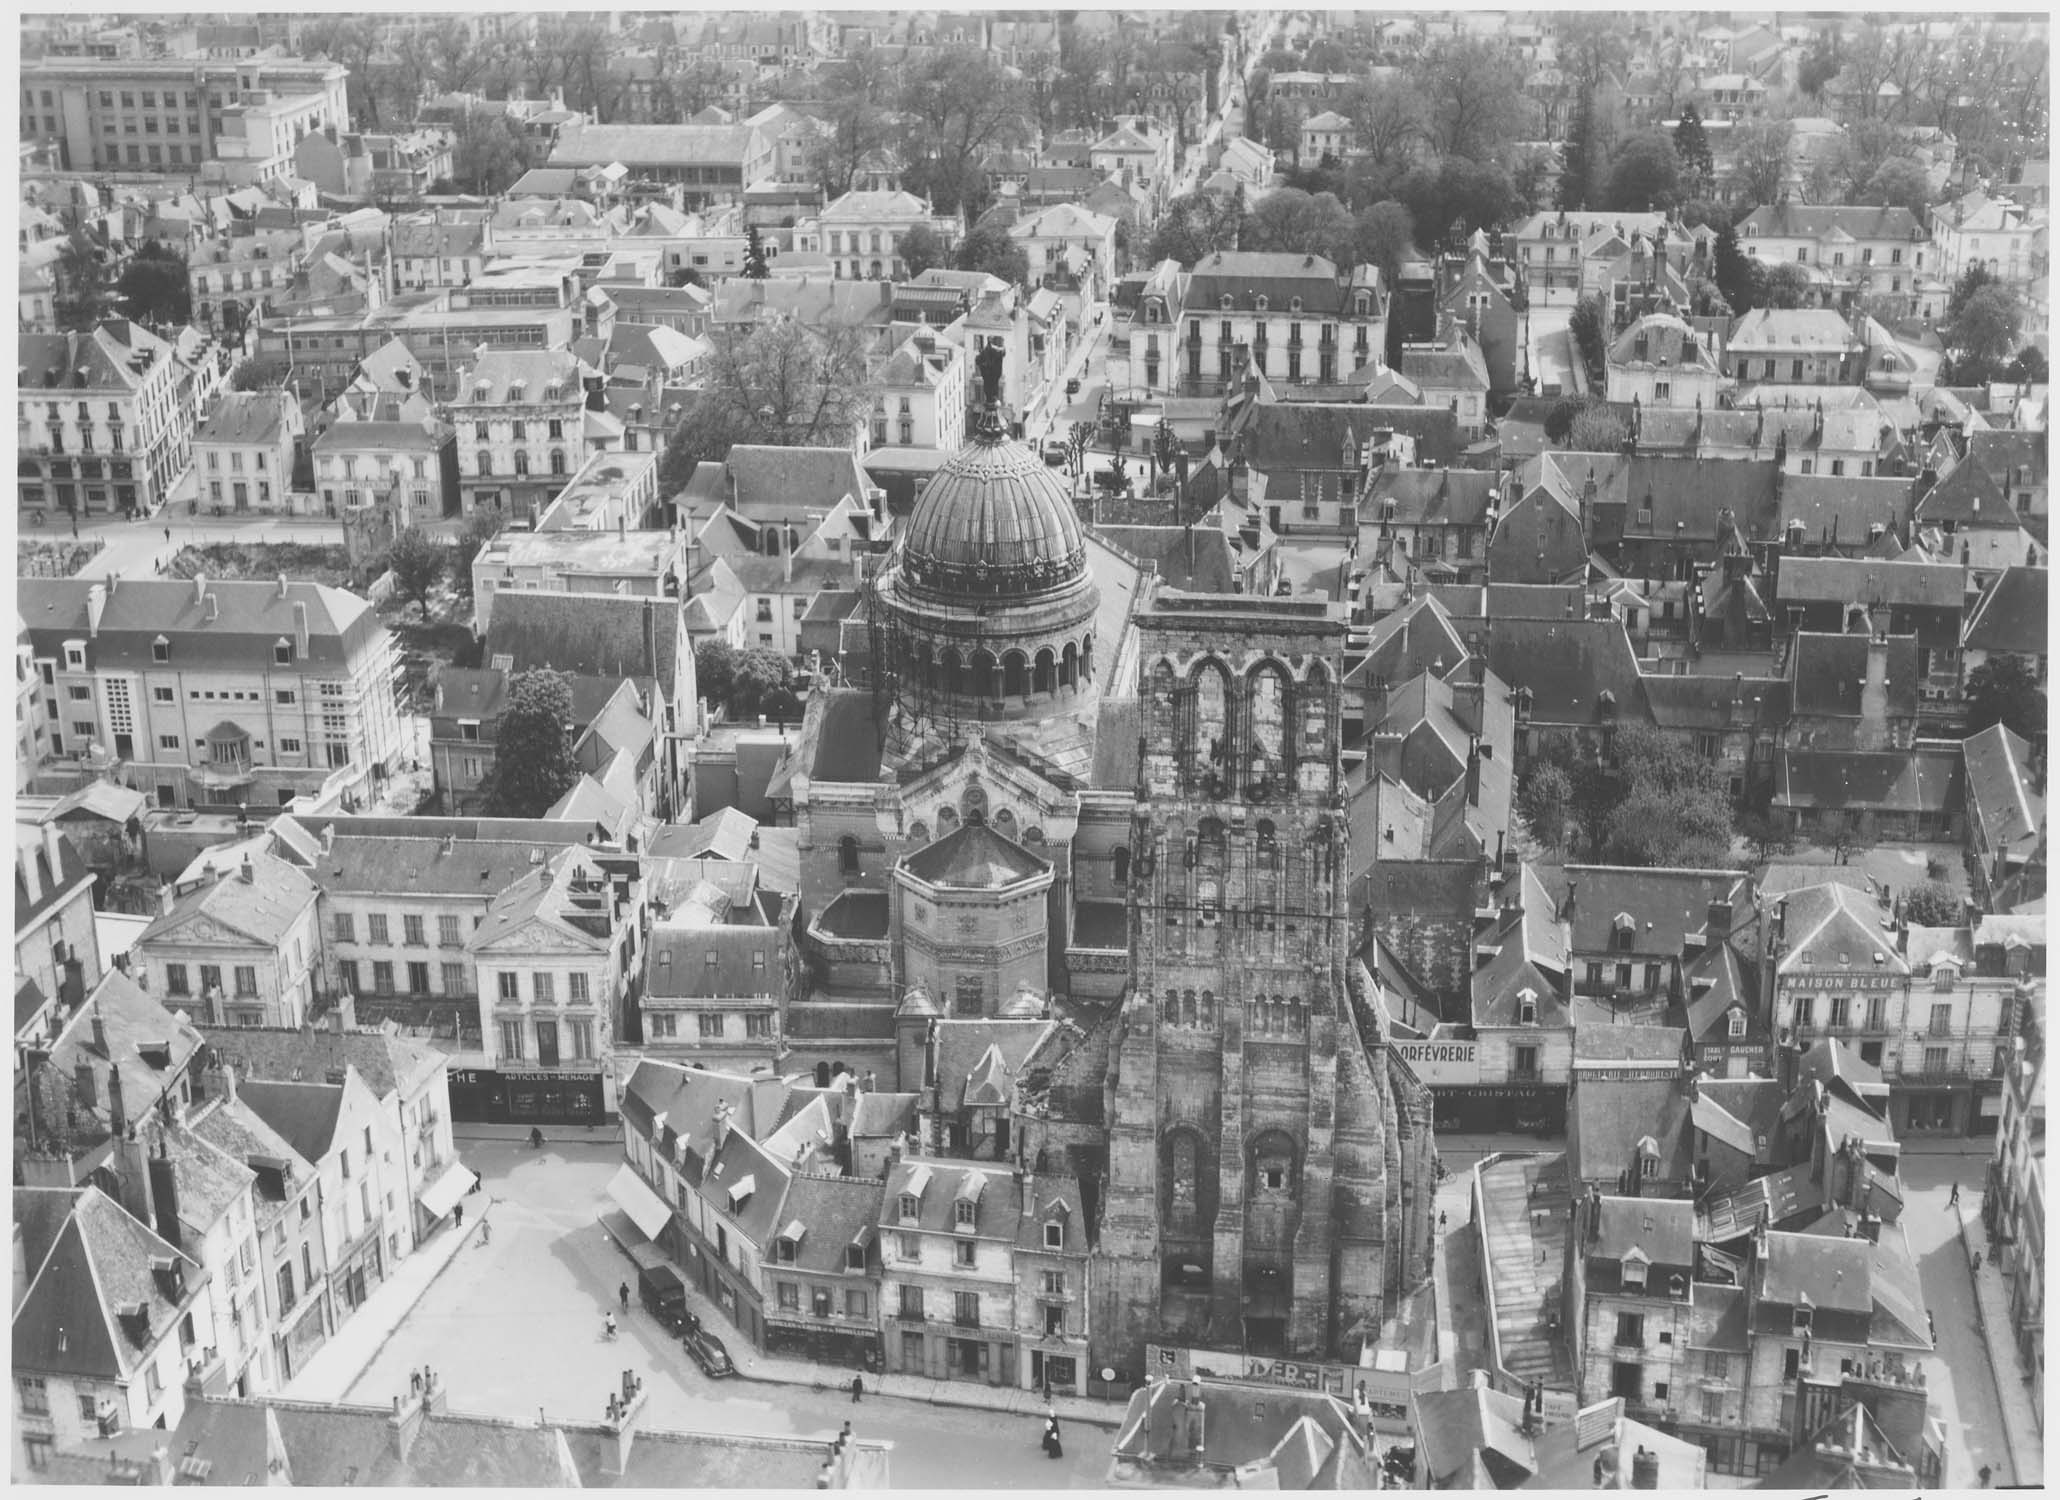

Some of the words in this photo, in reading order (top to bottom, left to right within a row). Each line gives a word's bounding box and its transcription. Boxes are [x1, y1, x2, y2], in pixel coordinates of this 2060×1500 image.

[1787, 977, 1843, 989] MAISON
[1849, 977, 1898, 989] BLEUE
[1730, 1045, 1763, 1055] GAUCHER
[504, 1072, 549, 1081] ARTICLES
